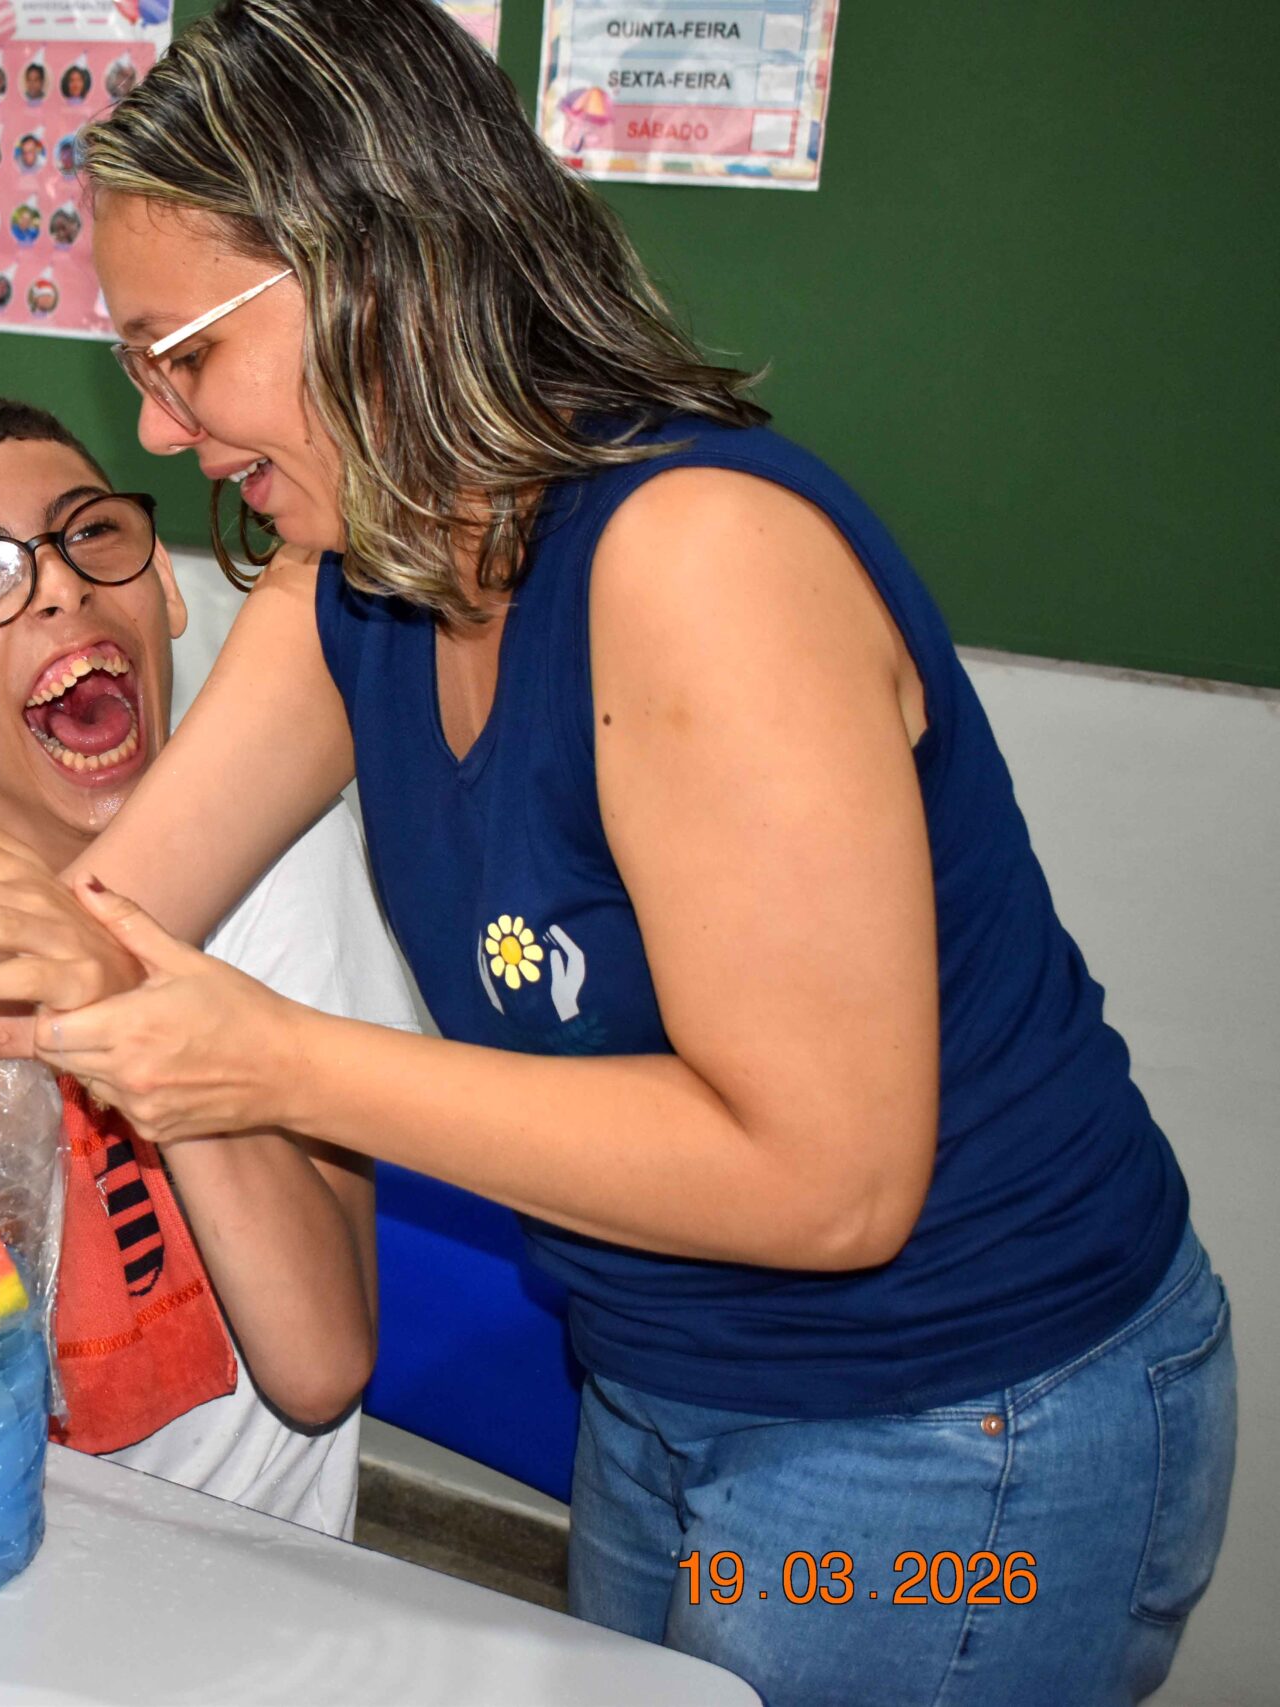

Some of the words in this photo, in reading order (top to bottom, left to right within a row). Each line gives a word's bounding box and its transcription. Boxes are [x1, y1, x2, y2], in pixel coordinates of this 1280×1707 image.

[606, 19, 741, 39] QUINTA-FEIRA
[607, 69, 732, 90] SEXTA-FEIRA
[626, 117, 709, 141] SÁBADO
